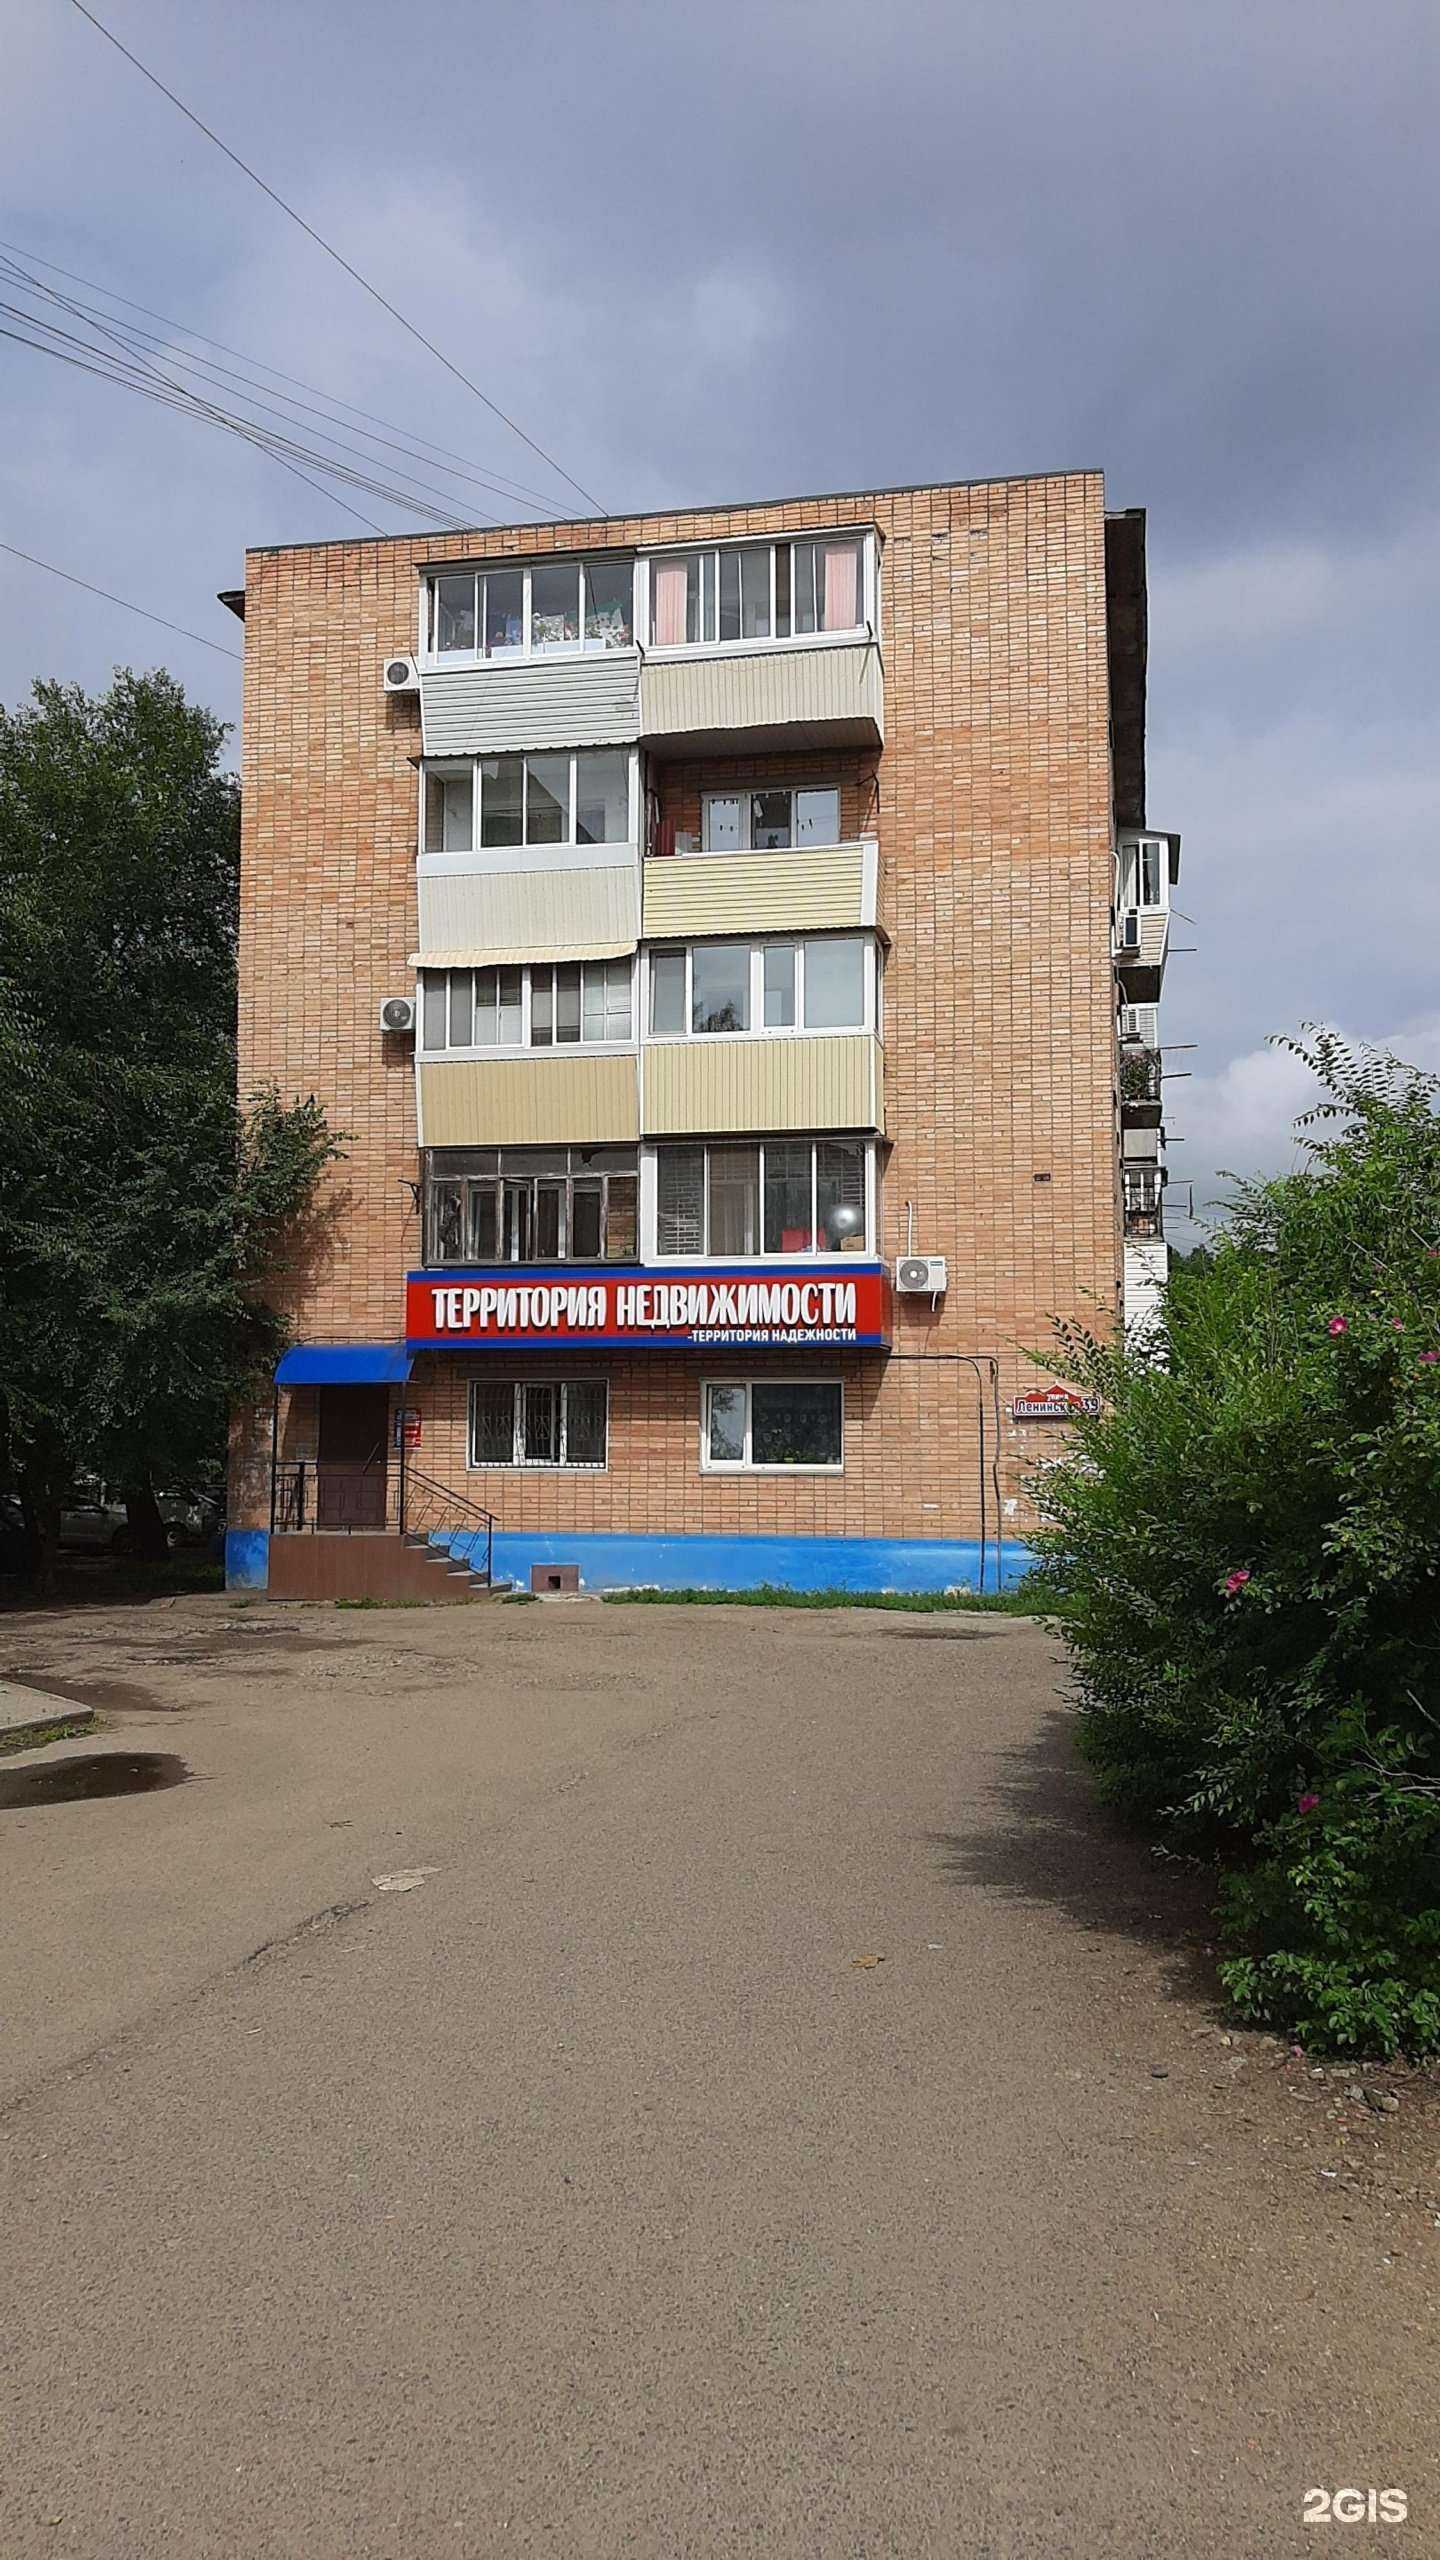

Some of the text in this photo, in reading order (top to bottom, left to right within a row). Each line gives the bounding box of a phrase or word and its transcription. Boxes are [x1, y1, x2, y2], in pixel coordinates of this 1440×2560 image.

[431, 1282, 857, 1329] ТЕРРИТОРИЯ НЕДВИЖИМОСТИ
[772, 1328, 857, 1343] НАДЕЖНОСТИ
[1082, 1397, 1099, 1412] 39
